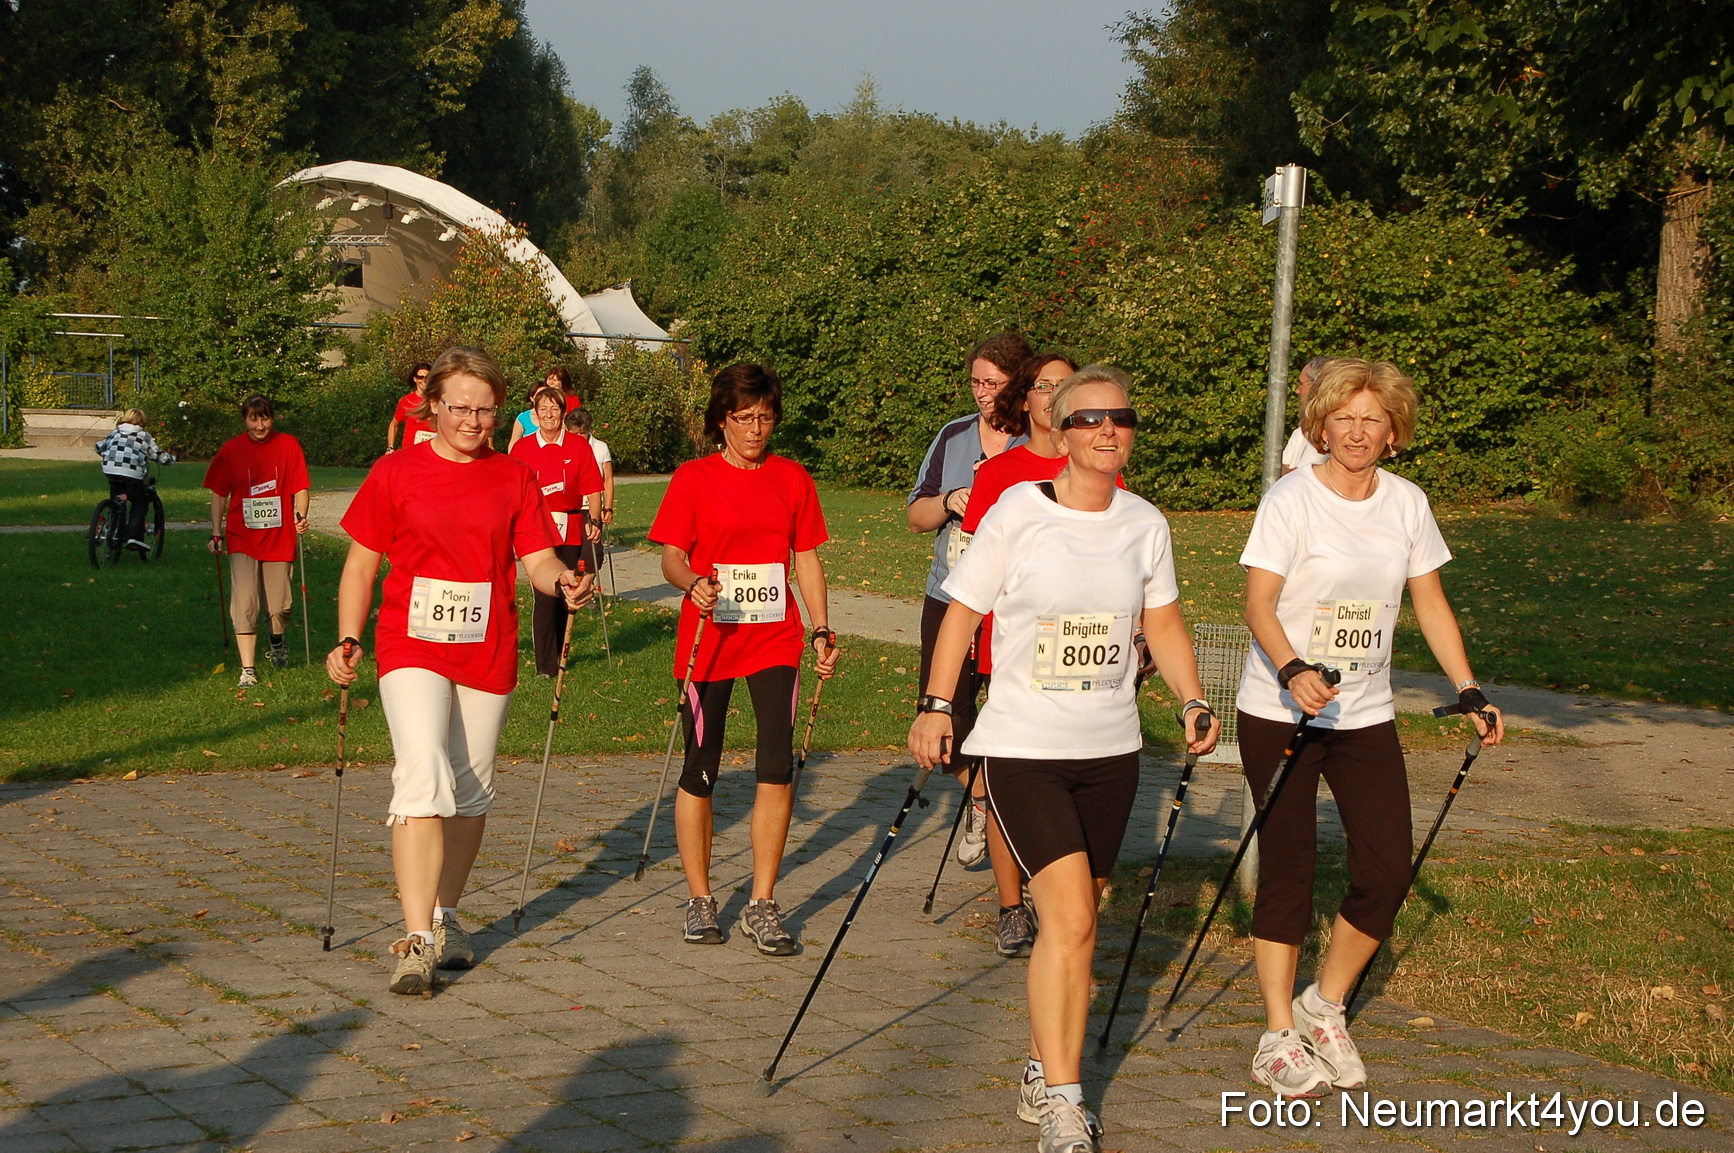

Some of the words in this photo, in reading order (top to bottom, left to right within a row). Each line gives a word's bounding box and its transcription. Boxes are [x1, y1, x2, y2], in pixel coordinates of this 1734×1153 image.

[254, 508, 278, 519] 8022
[732, 569, 757, 580] Erika
[441, 589, 470, 602] Moni
[734, 586, 779, 603] 8069
[413, 600, 420, 609] N
[432, 604, 482, 623] 8115
[1337, 605, 1372, 620] Christl
[1063, 620, 1109, 639] Brigitte
[1314, 625, 1322, 636] N
[1334, 628, 1382, 649] 8001
[1037, 643, 1045, 654] N
[1062, 644, 1121, 667] 8002
